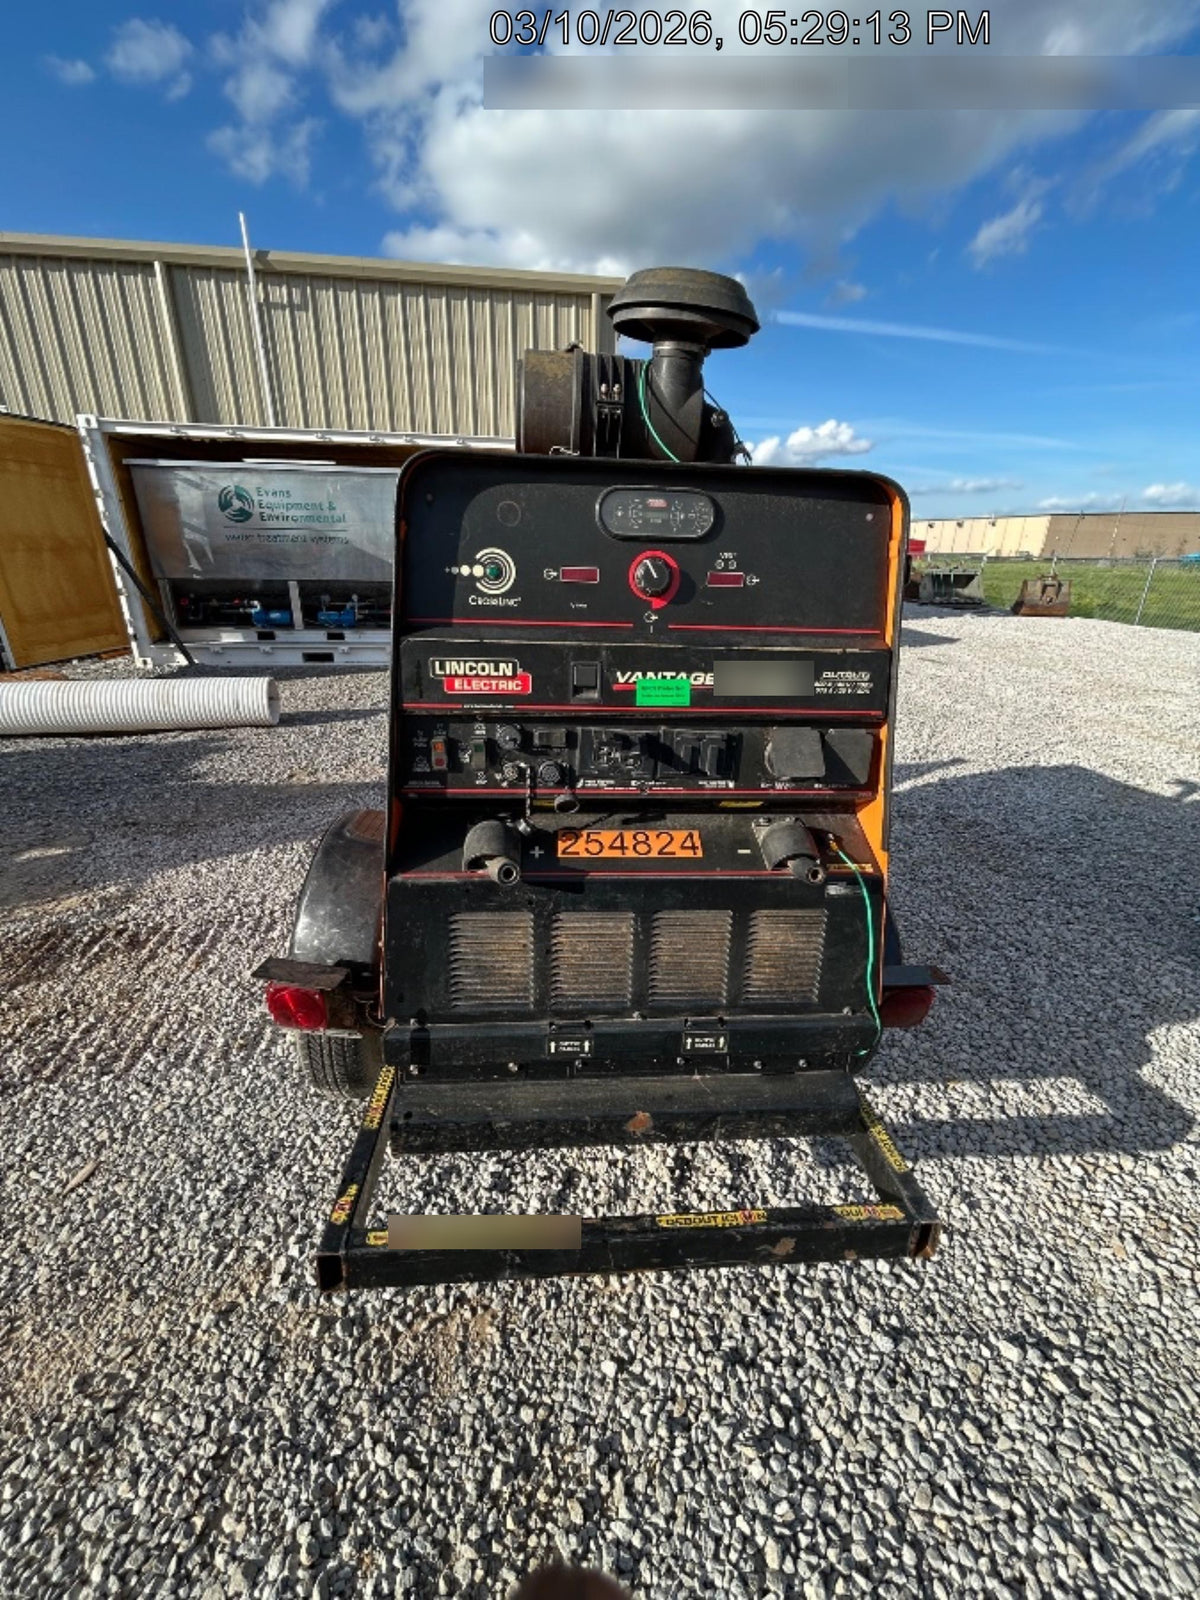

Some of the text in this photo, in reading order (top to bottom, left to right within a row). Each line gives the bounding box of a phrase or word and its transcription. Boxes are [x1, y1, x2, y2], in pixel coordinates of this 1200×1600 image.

[256, 486, 292, 498] Evans
[258, 499, 337, 513] Equipment &
[260, 511, 347, 524] Environmental
[434, 660, 514, 677] LINCOLN
[454, 678, 523, 691] ELECTRIC
[558, 830, 700, 857] 254824
